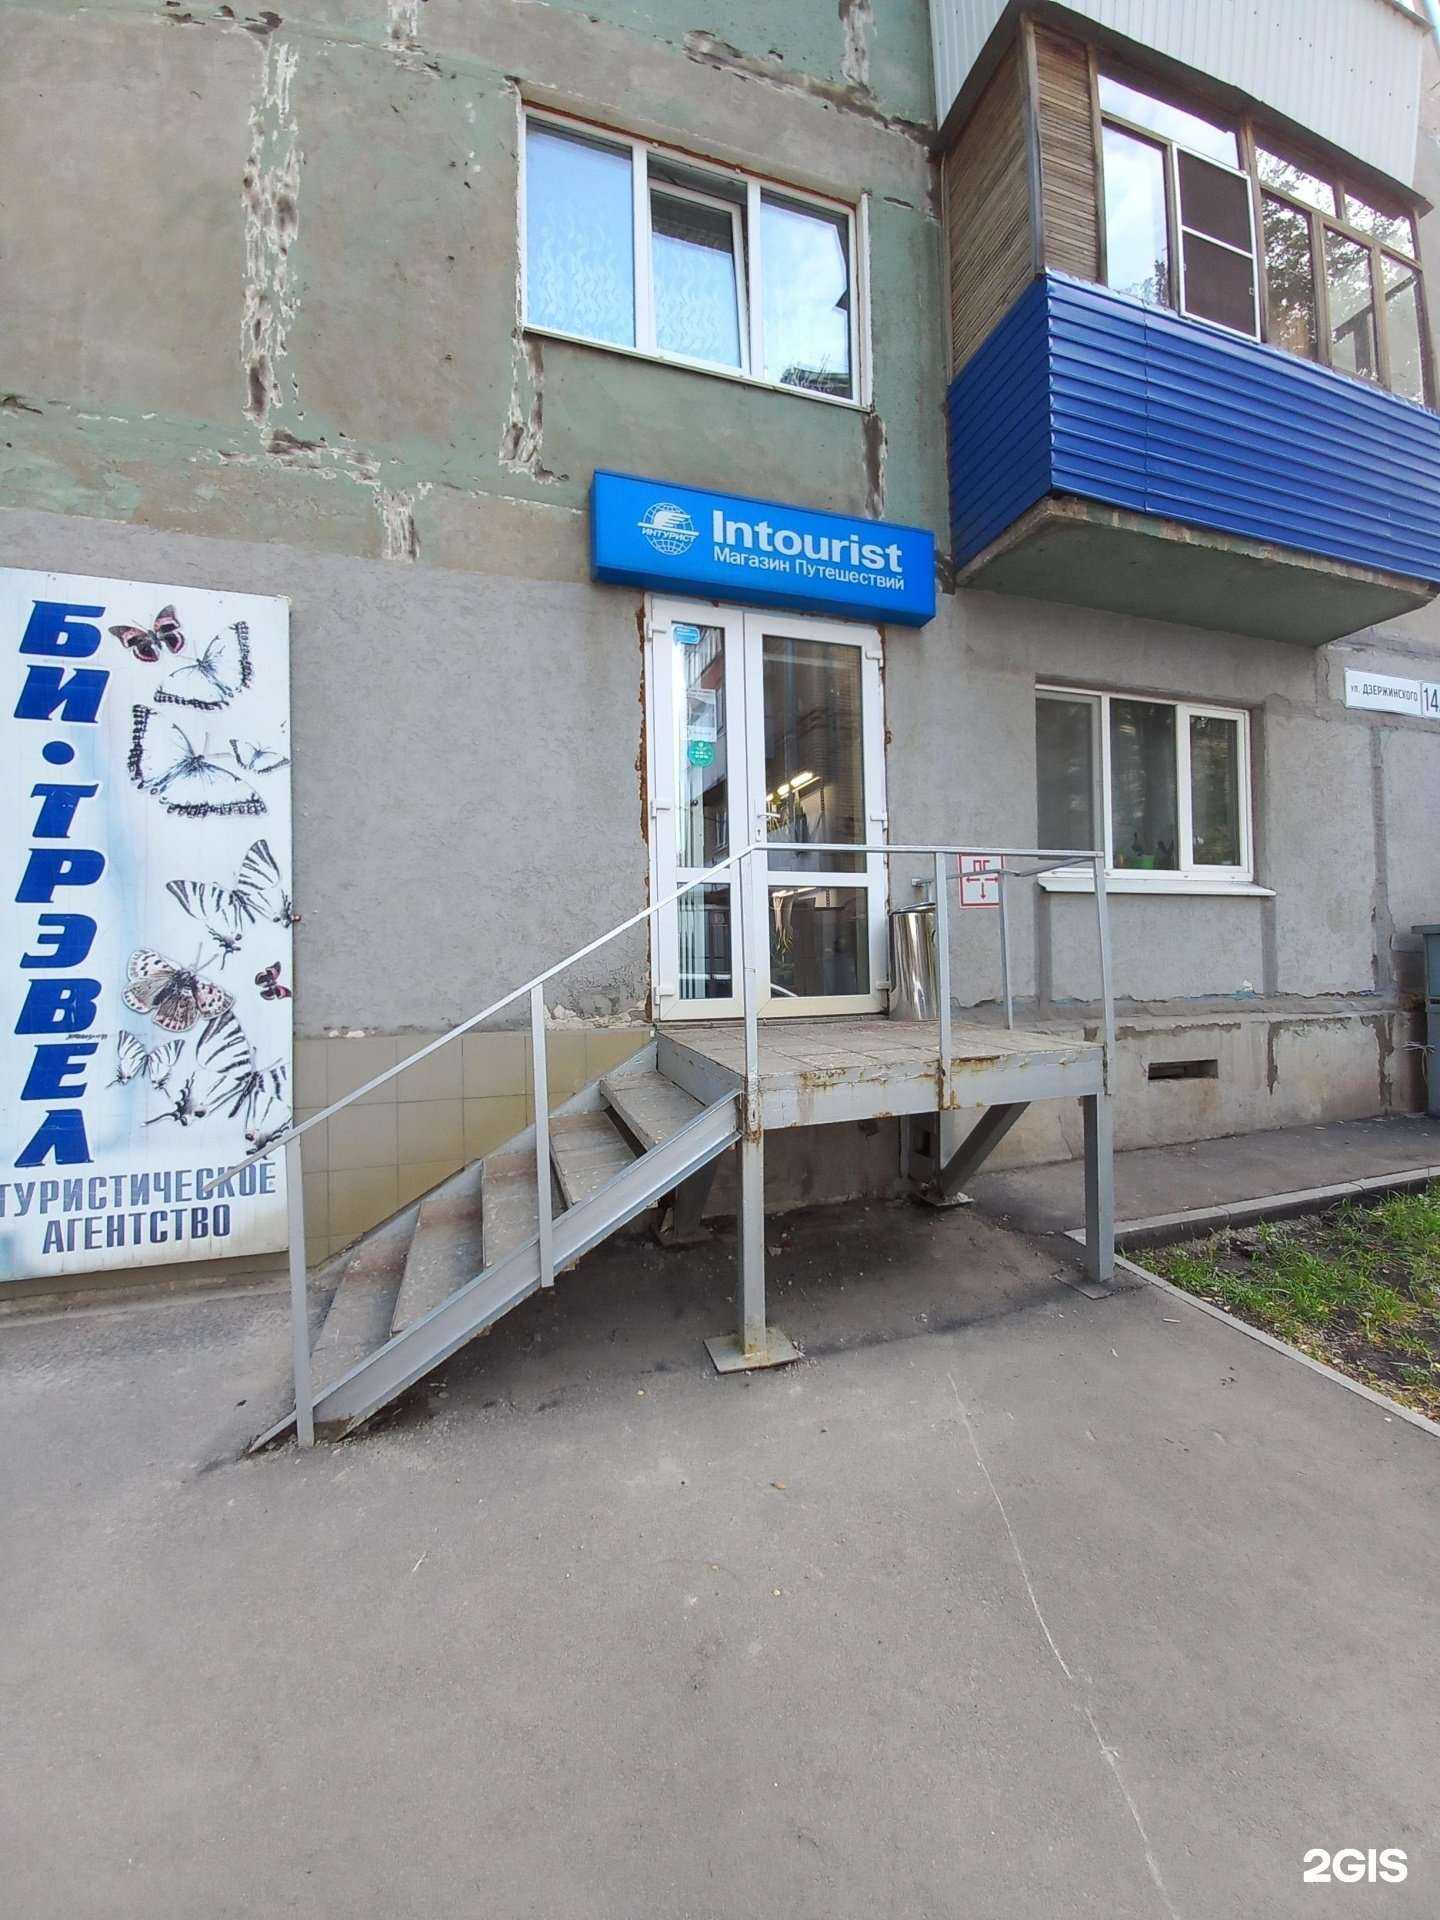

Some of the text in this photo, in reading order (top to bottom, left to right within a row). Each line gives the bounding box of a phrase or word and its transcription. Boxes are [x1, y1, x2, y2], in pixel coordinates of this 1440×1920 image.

[641, 526, 698, 543] ИНТУРИСТ
[713, 509, 903, 573] Intourist
[713, 546, 904, 591] Магазин Путешествий
[1362, 683, 1419, 702] ДЗЕРЖИНСКОГО
[1424, 687, 1440, 713] 14
[0, 1162, 276, 1218] ТУРИСТИЧЕСКОЕ
[42, 1204, 231, 1254] АГЕНТСТВО
